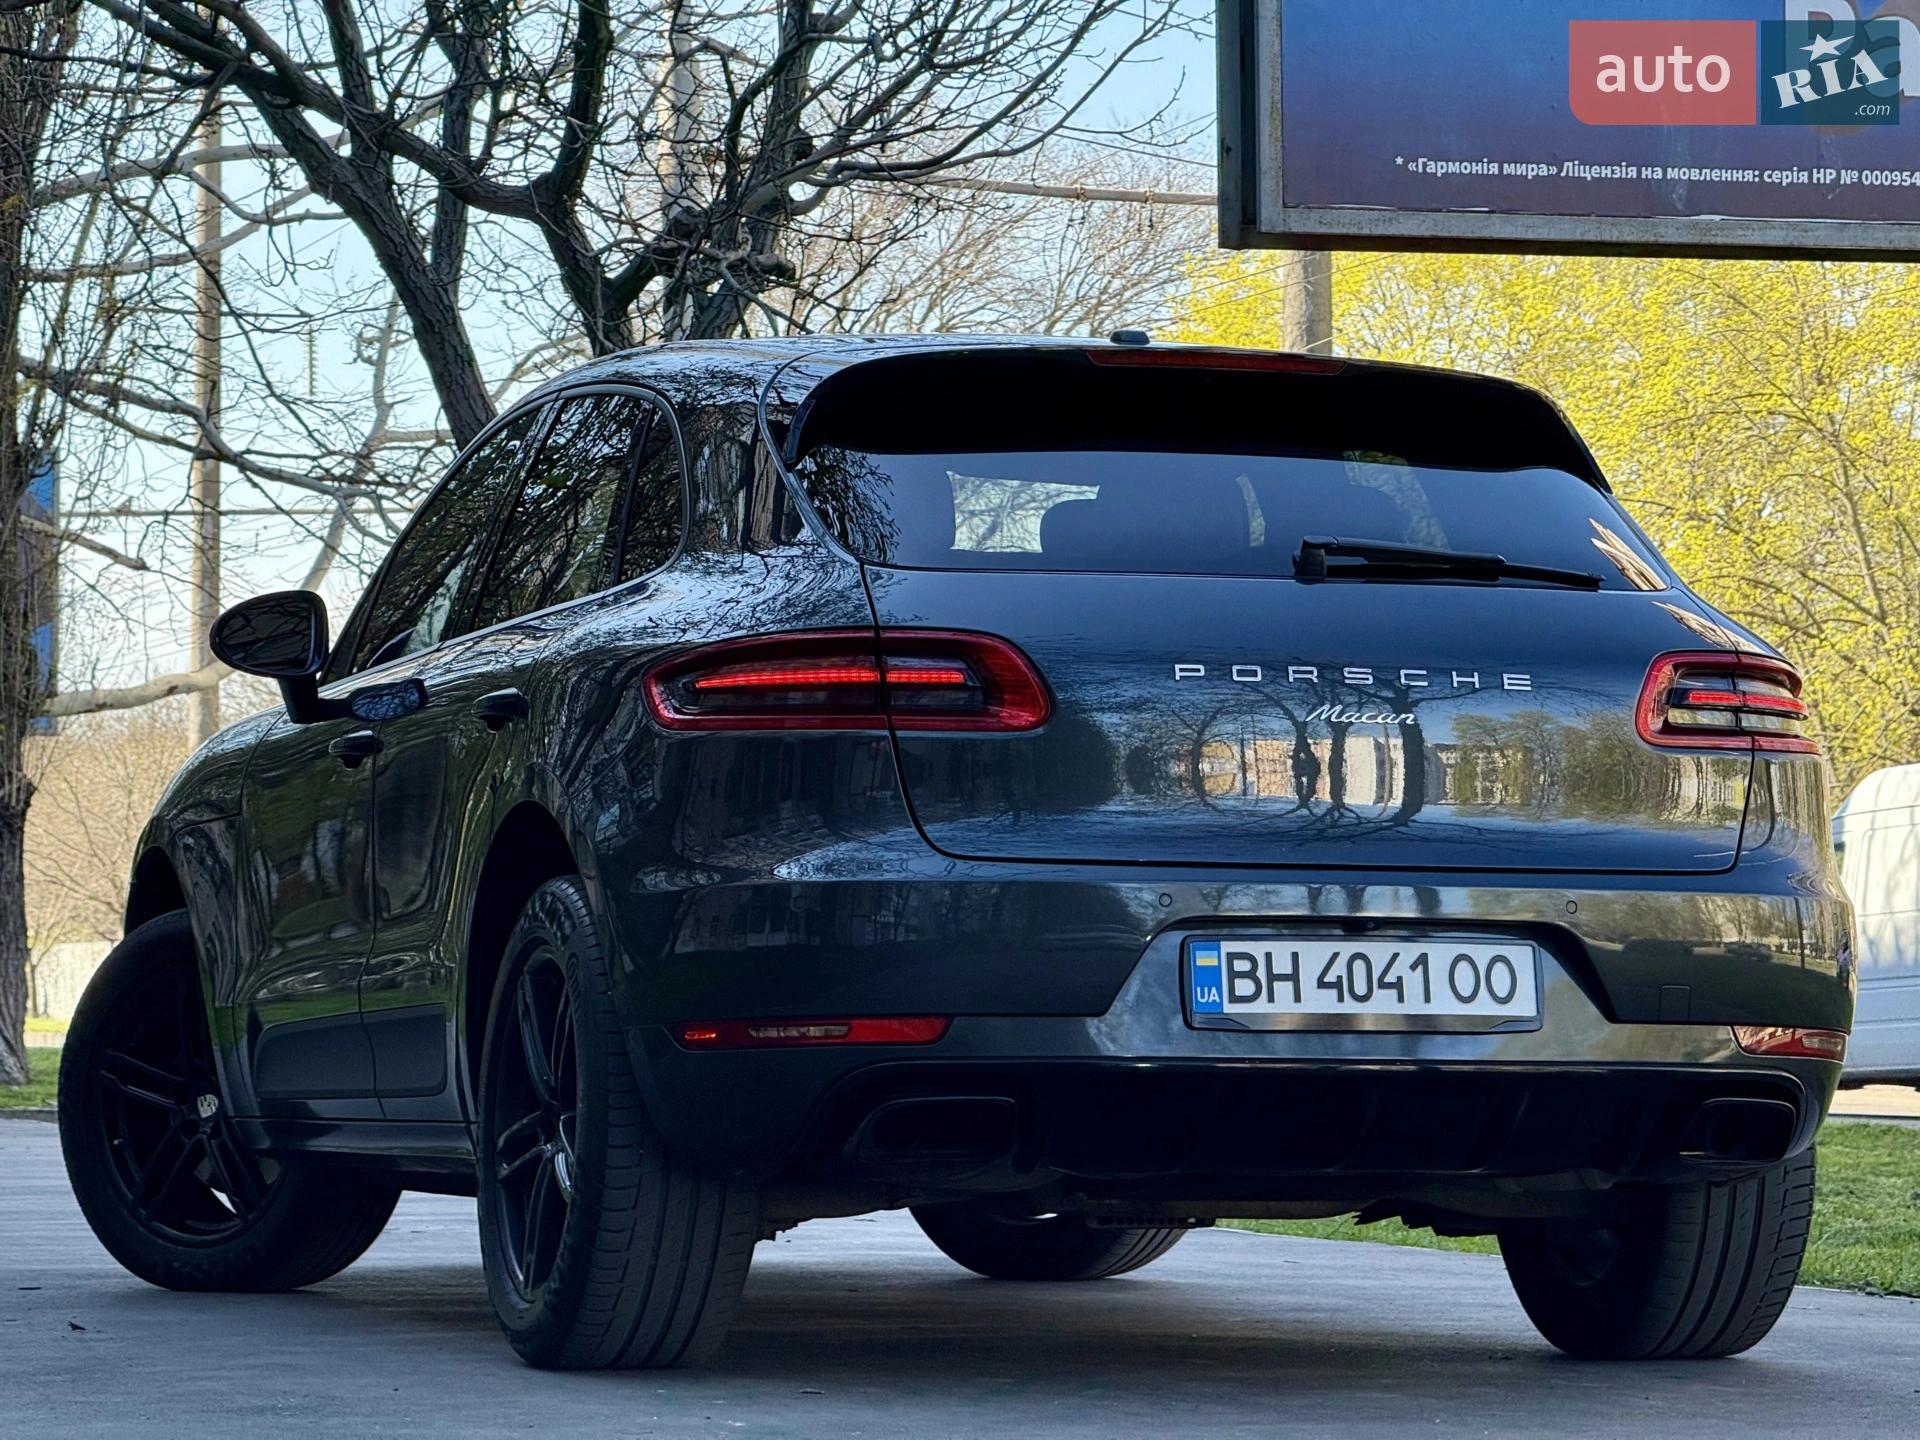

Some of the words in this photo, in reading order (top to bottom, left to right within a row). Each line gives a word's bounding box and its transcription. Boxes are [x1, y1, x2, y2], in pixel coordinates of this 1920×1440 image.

[1407, 157, 1499, 177] «Гармонія
[1502, 162, 1558, 179] мира»
[1560, 160, 1637, 181] Ліцензія
[1641, 166, 1663, 180] на
[1666, 166, 1760, 183] мовлення:
[1763, 166, 1809, 186] серія
[1174, 664, 1533, 691] PORSCHE
[1305, 703, 1415, 725] Macan
[1226, 952, 1302, 1004] BH
[1317, 952, 1432, 1004] 4041
[1449, 953, 1518, 1005] OO
[1196, 986, 1220, 1003] UA
